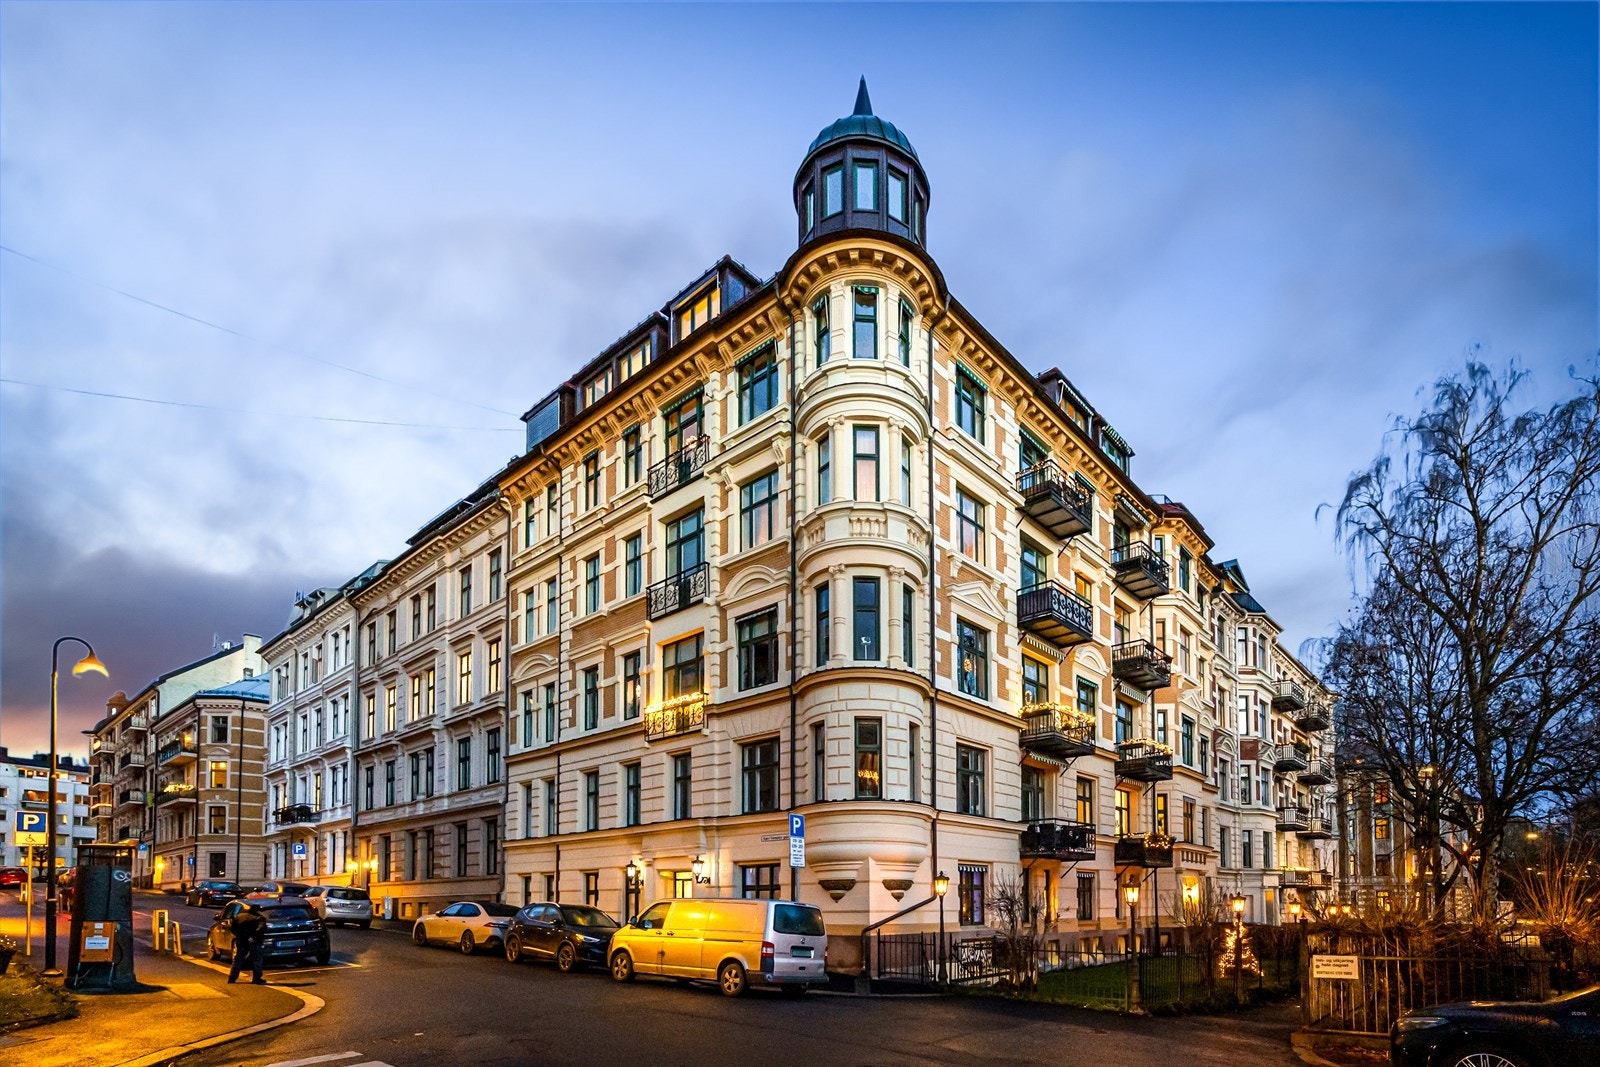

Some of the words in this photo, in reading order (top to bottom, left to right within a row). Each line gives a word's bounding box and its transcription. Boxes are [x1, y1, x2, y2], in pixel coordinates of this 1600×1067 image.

[23, 814, 40, 830] P
[793, 817, 801, 834] P
[295, 845, 303, 853] P
